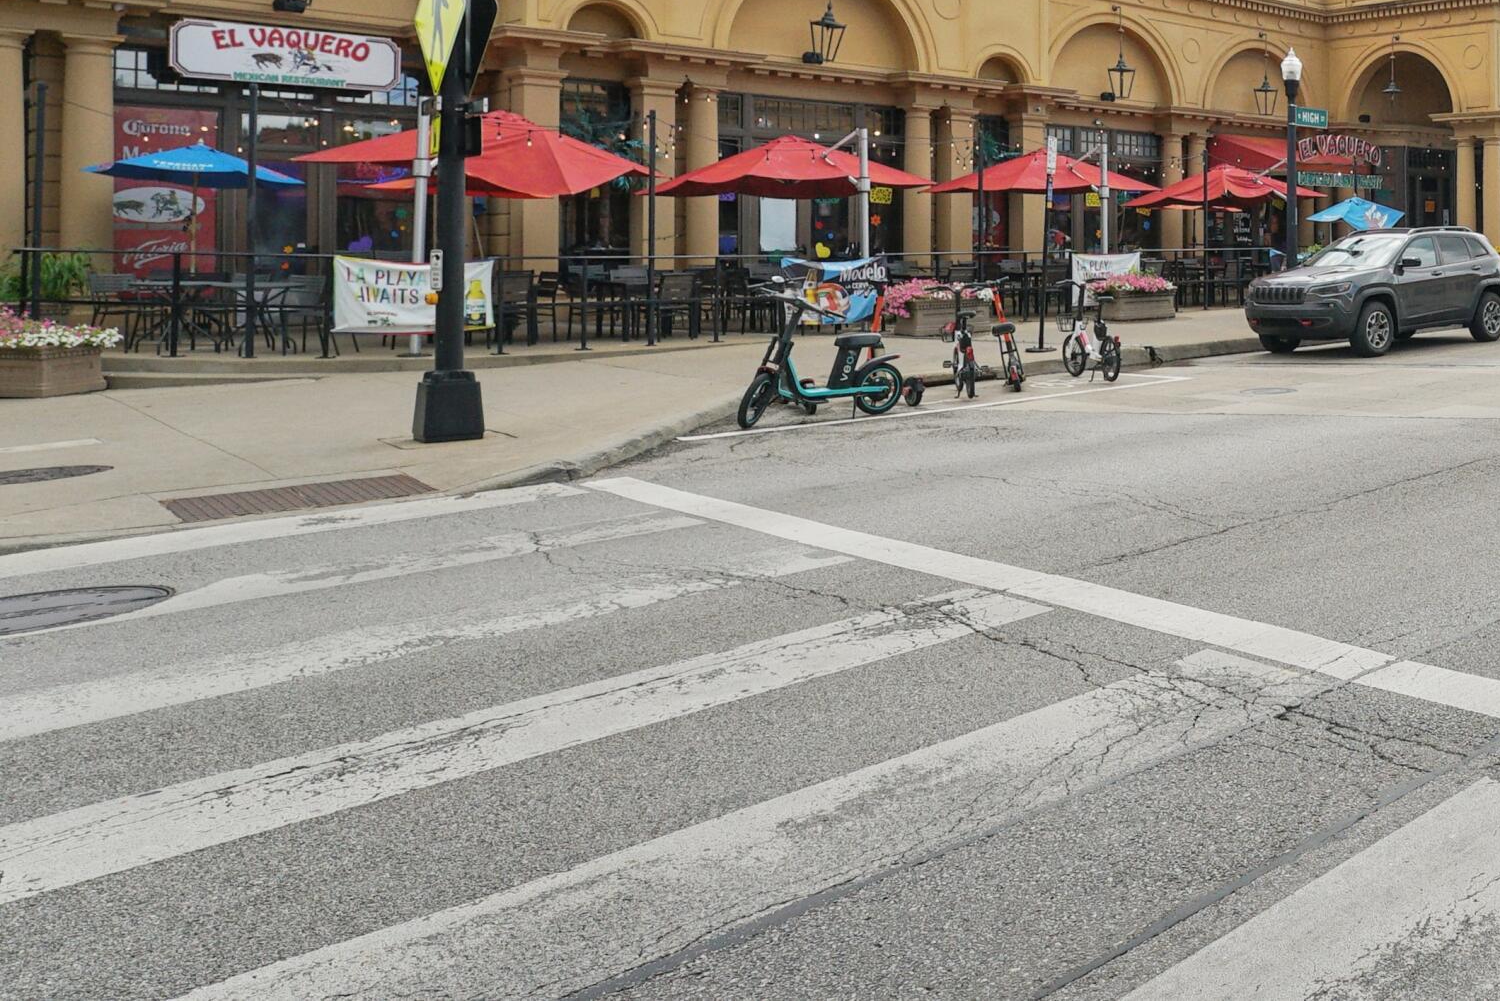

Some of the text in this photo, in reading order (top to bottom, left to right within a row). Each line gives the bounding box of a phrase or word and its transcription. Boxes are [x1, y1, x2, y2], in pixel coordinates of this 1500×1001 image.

[211, 28, 370, 62] EL VAQUERO
[233, 71, 347, 87] MEXICAN RESTAURANT
[122, 117, 191, 136] Corona
[1302, 111, 1320, 124] HIGH
[1298, 133, 1382, 167] EL VAQUERO
[345, 267, 366, 284] LA
[375, 269, 427, 287] PLAYA
[839, 262, 886, 282] Modelo
[354, 286, 419, 305] AWAITS
